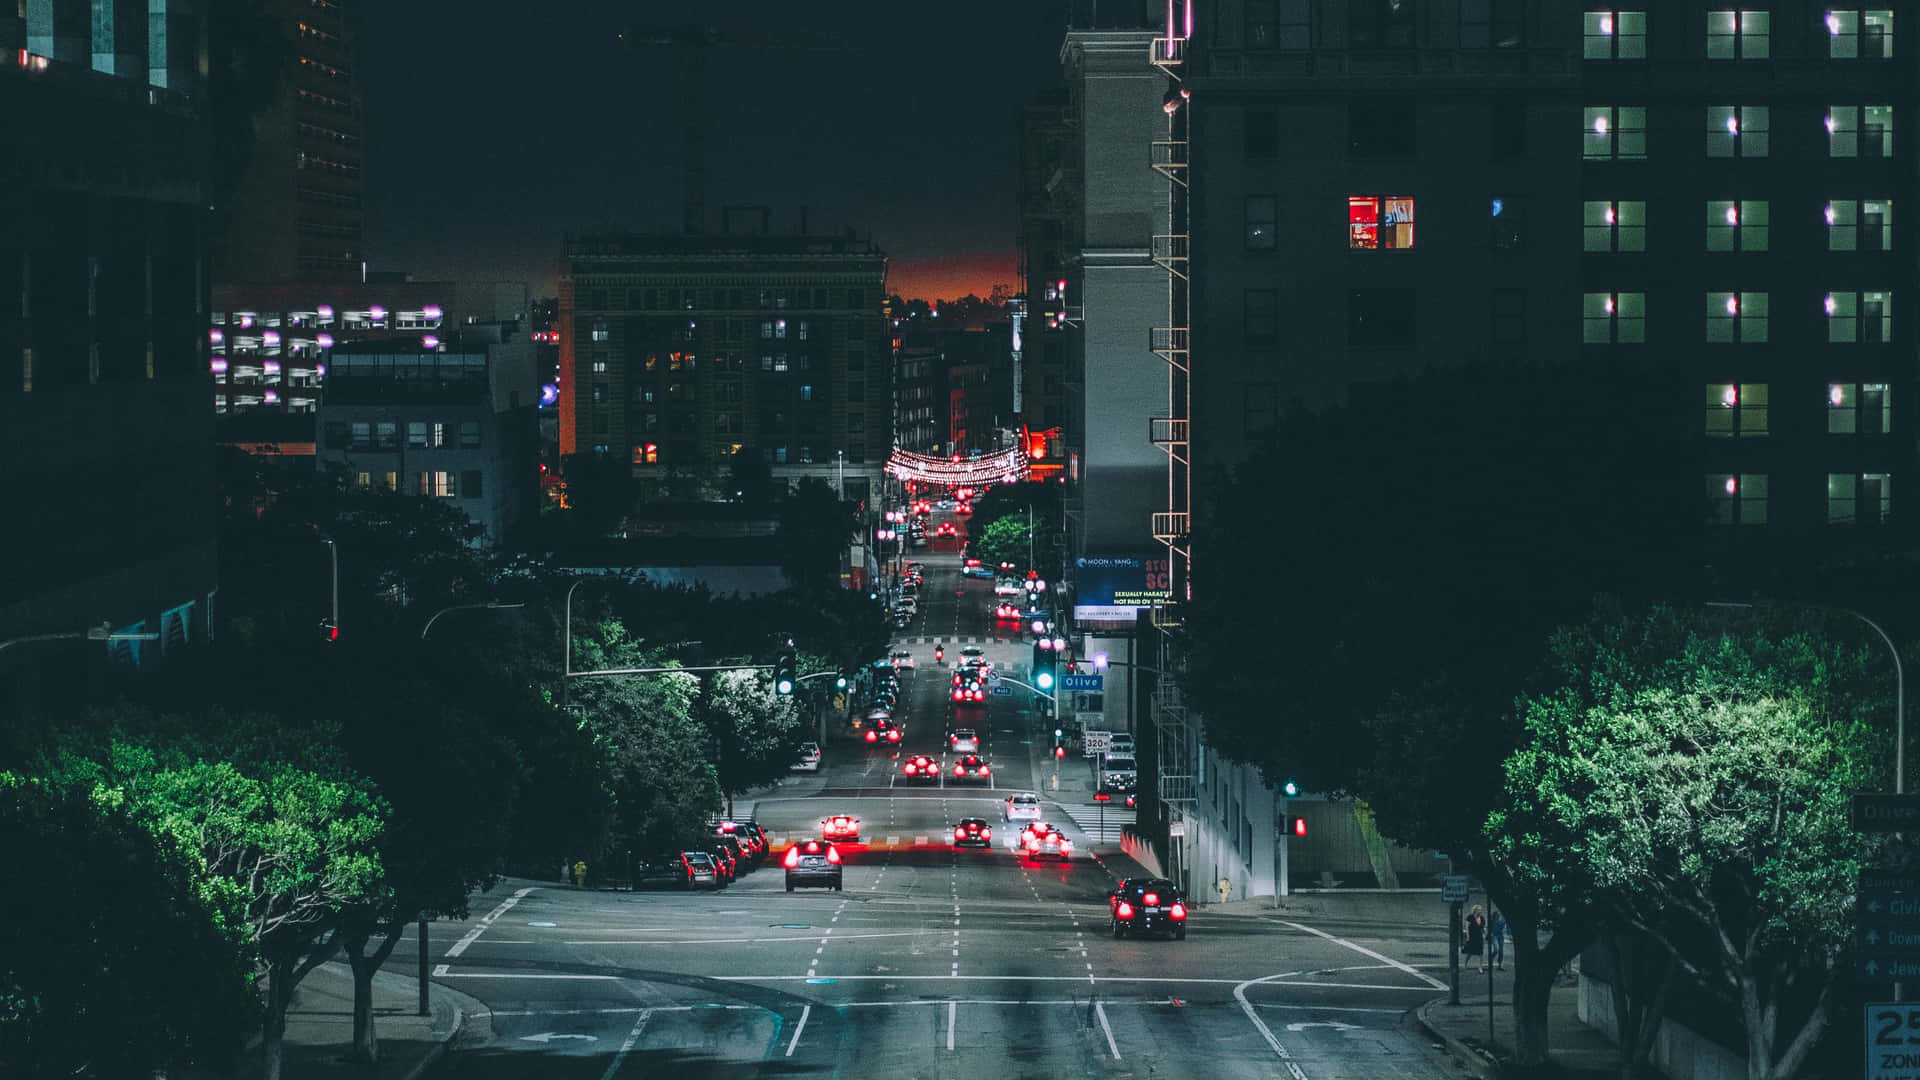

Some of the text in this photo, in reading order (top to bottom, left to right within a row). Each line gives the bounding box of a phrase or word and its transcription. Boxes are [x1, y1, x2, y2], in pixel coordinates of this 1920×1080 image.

[1145, 560, 1167, 571] STO
[1145, 573, 1168, 590] SC
[1066, 677, 1098, 687] Olive
[1087, 739, 1103, 747] 320
[1889, 899, 1920, 915] Civi
[1888, 959, 1920, 976] Jew
[1880, 1054, 1920, 1069] ZON
